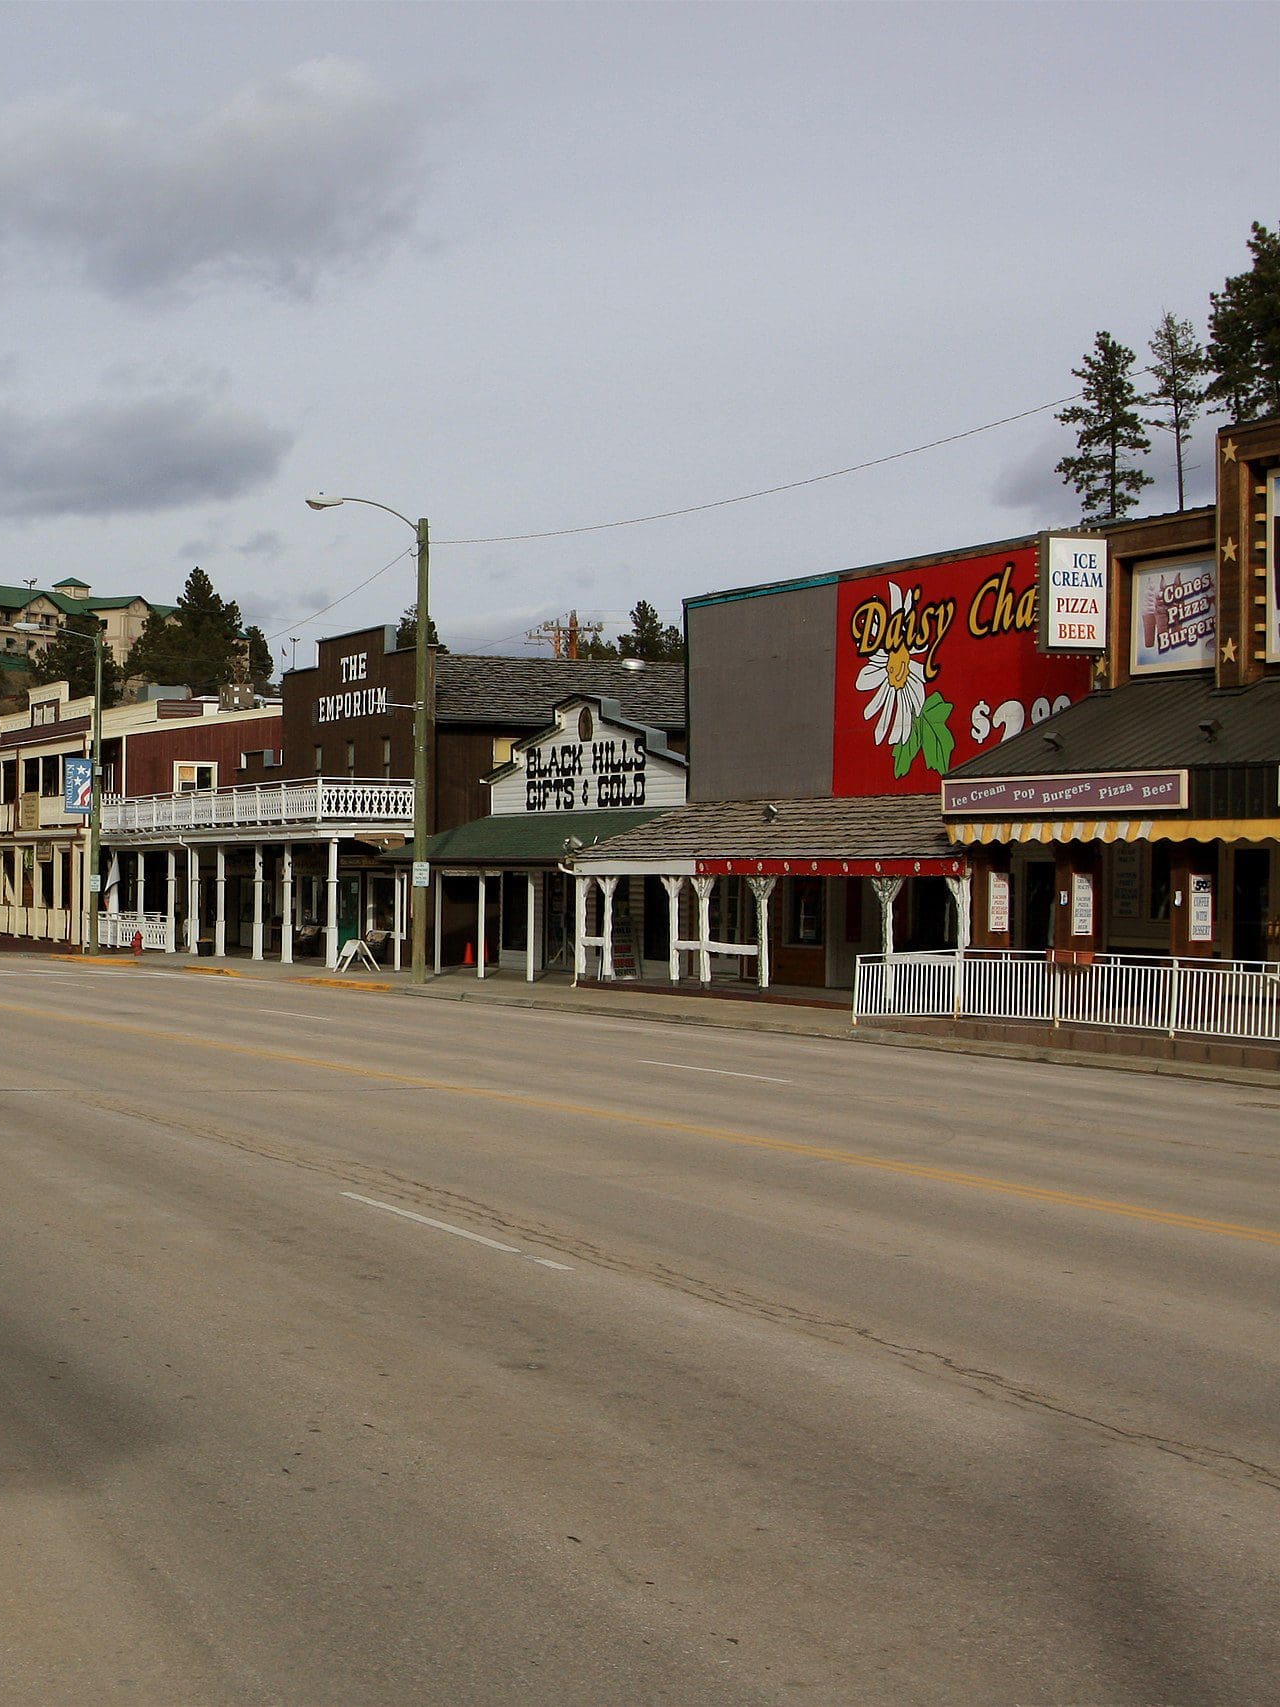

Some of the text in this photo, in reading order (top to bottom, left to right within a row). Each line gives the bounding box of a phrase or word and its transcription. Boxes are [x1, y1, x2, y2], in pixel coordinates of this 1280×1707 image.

[1073, 553, 1097, 569] ICE
[1052, 571, 1103, 588] CREAM
[1163, 573, 1211, 604] Cones
[1056, 597, 1099, 614] PIZZA
[1167, 597, 1210, 625] Pizza
[851, 586, 955, 680] Daisy
[1058, 624, 1096, 640] BEER
[1158, 618, 1216, 652] Burger
[340, 652, 368, 684] THE
[318, 686, 388, 723] EMPORIUM
[526, 738, 646, 779] BLACK HILLS
[526, 772, 646, 811] GIFTS & GOLD
[951, 782, 1174, 808] Ice Cream Pop Burgers Pizza Beer
